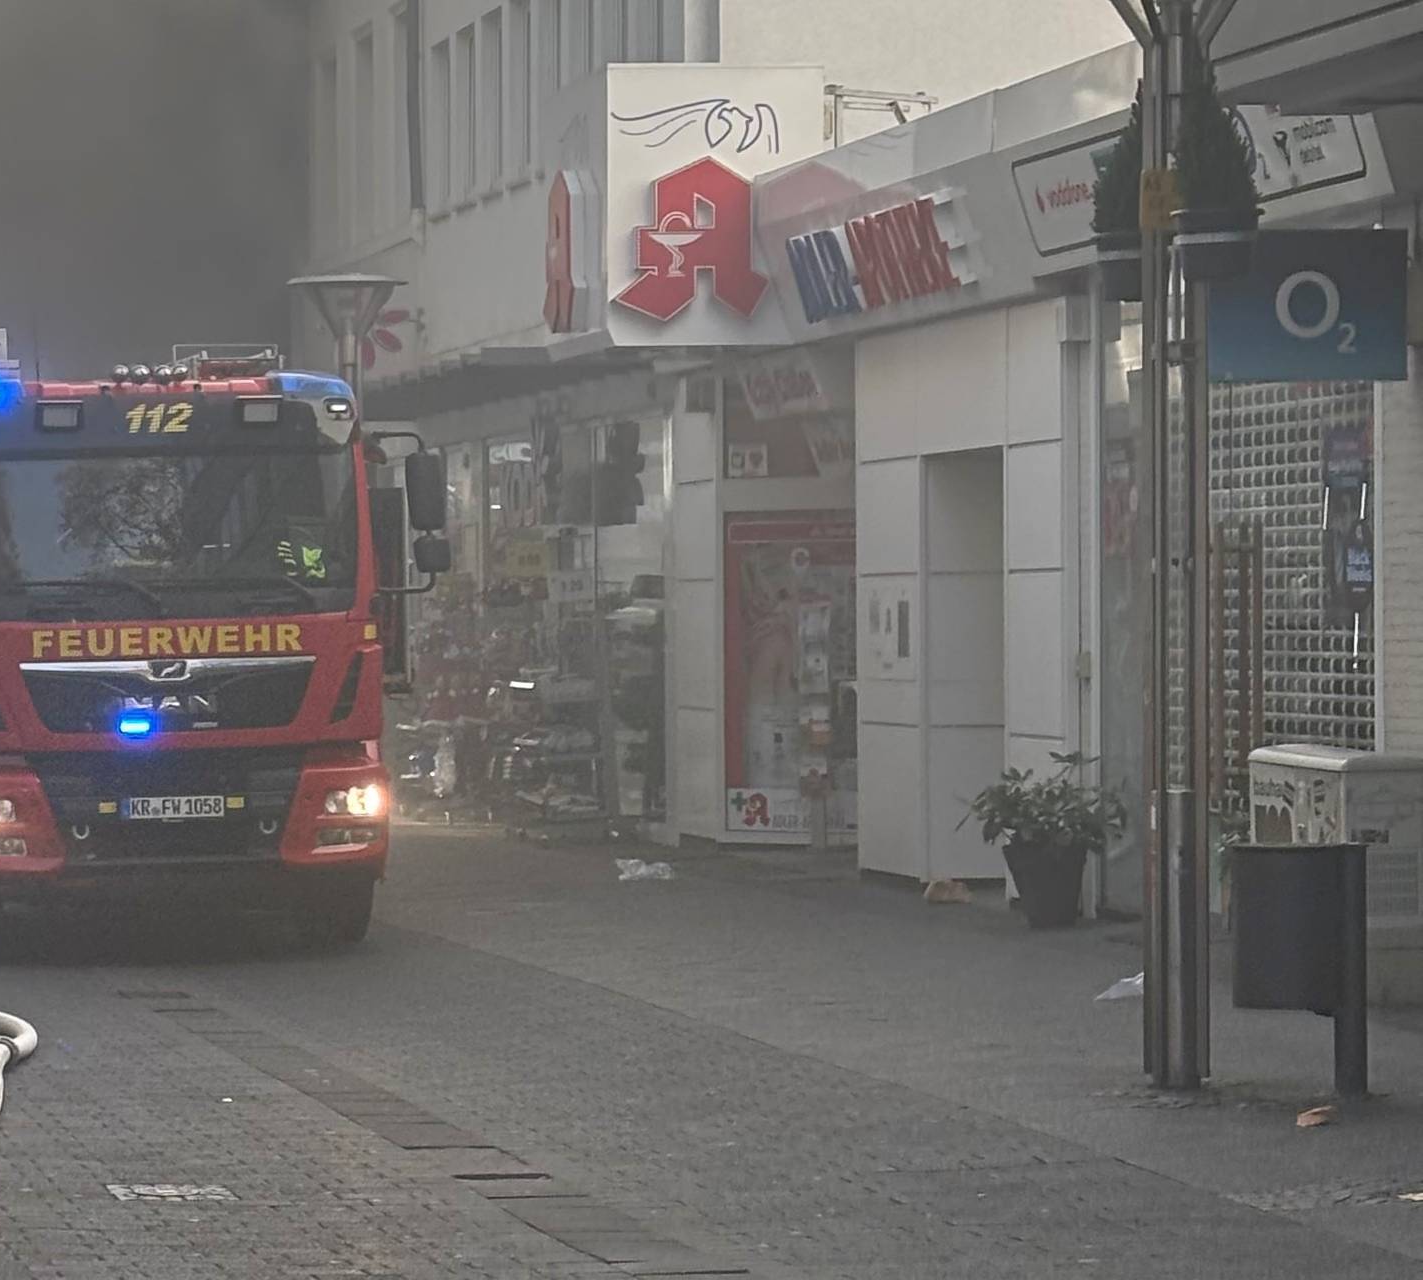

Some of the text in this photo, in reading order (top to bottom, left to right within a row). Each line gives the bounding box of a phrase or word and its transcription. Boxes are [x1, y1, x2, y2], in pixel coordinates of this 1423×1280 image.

[126, 402, 193, 434] 112
[31, 623, 303, 659] FEUERWEHR
[131, 797, 223, 817] KR FW 1058
